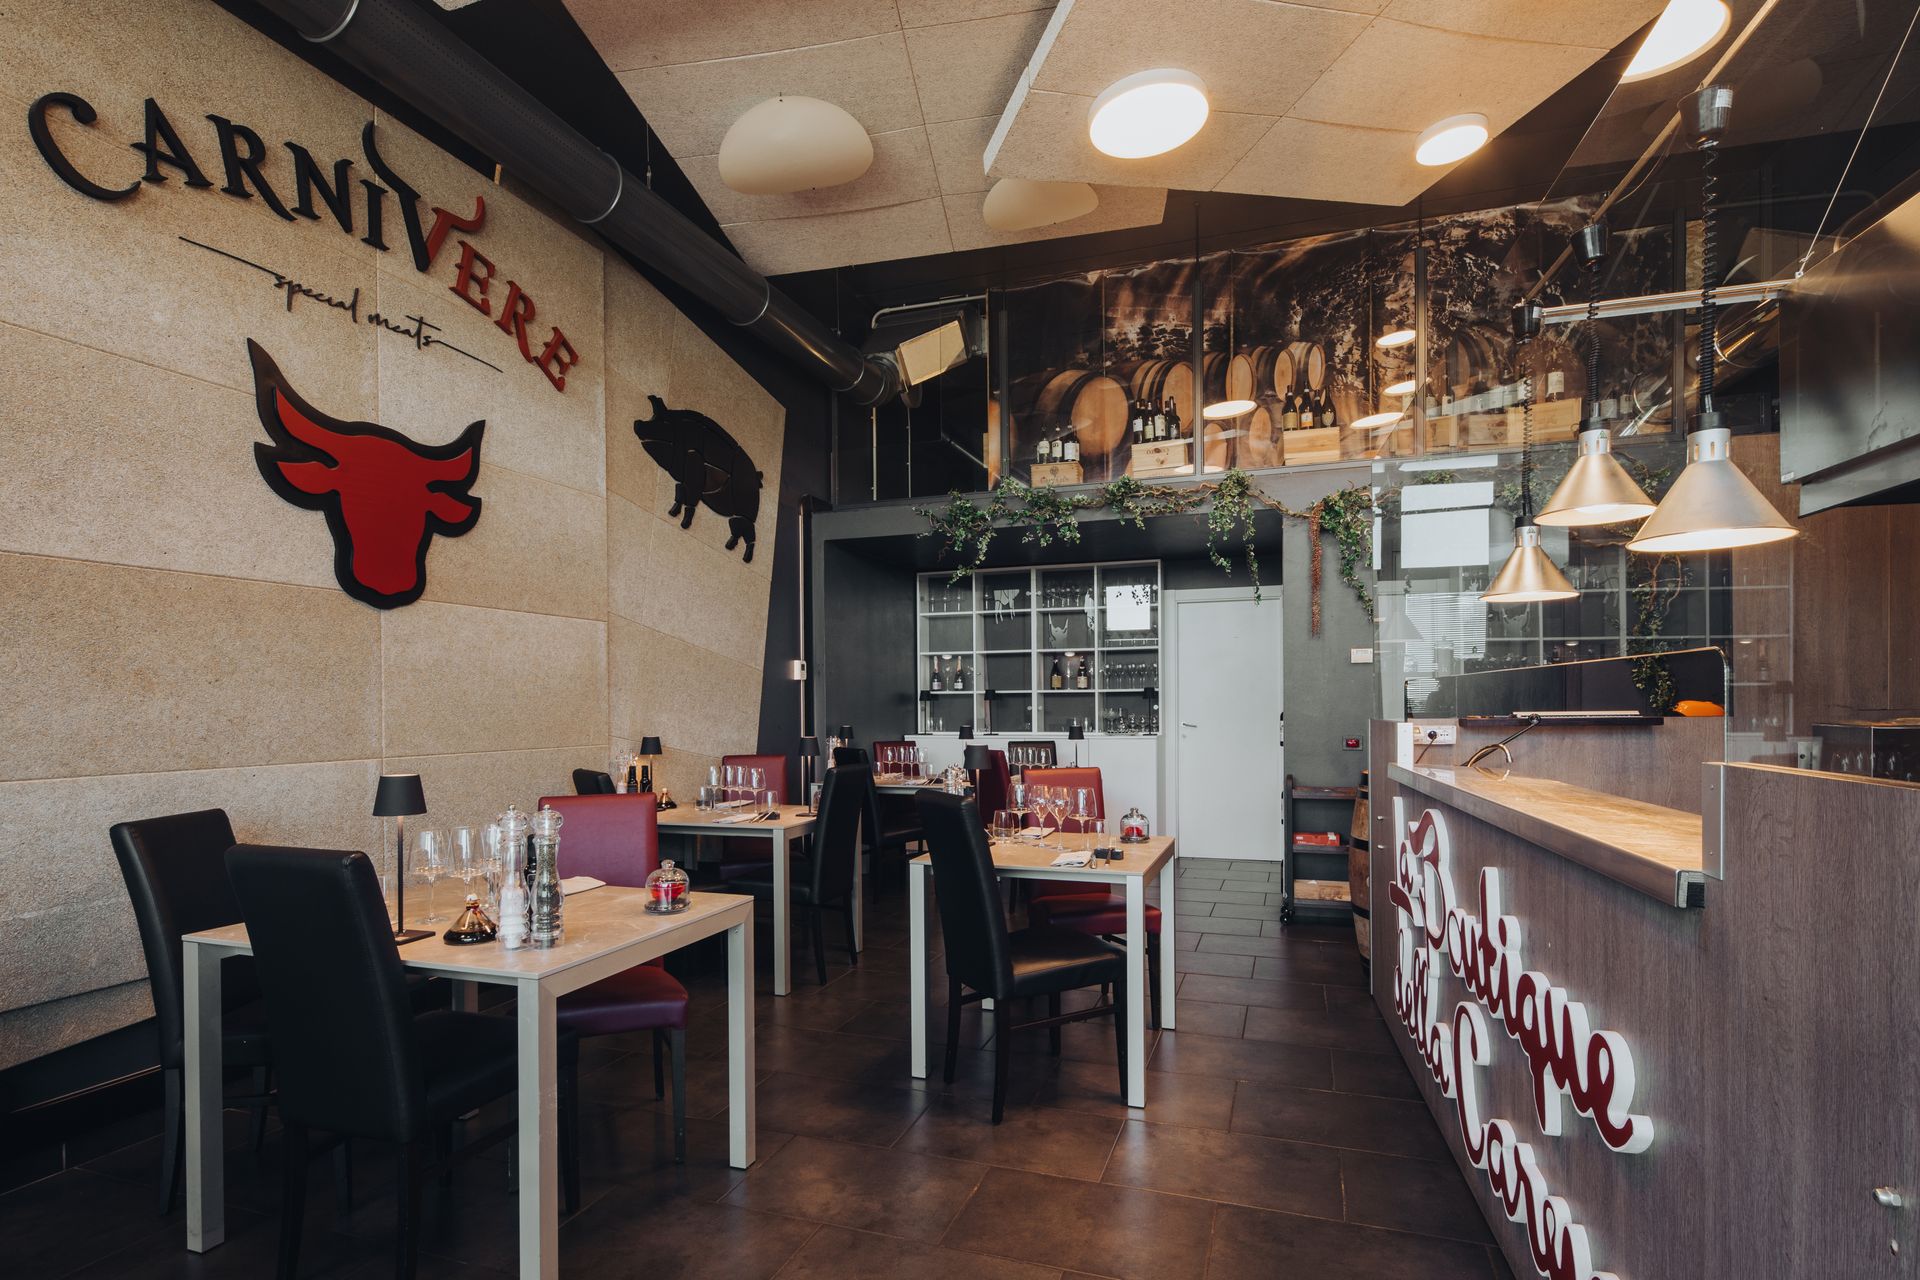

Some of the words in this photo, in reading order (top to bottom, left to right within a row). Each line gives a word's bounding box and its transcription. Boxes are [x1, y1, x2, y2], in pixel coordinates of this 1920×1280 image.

[28, 92, 580, 392] CARNIVERE
[274, 275, 360, 323] special
[367, 313, 442, 350] meats
[1388, 795, 1424, 928] La
[1407, 808, 1655, 1154] Boutique
[1393, 924, 1457, 1098] della
[1453, 1001, 1622, 1280] Carn
